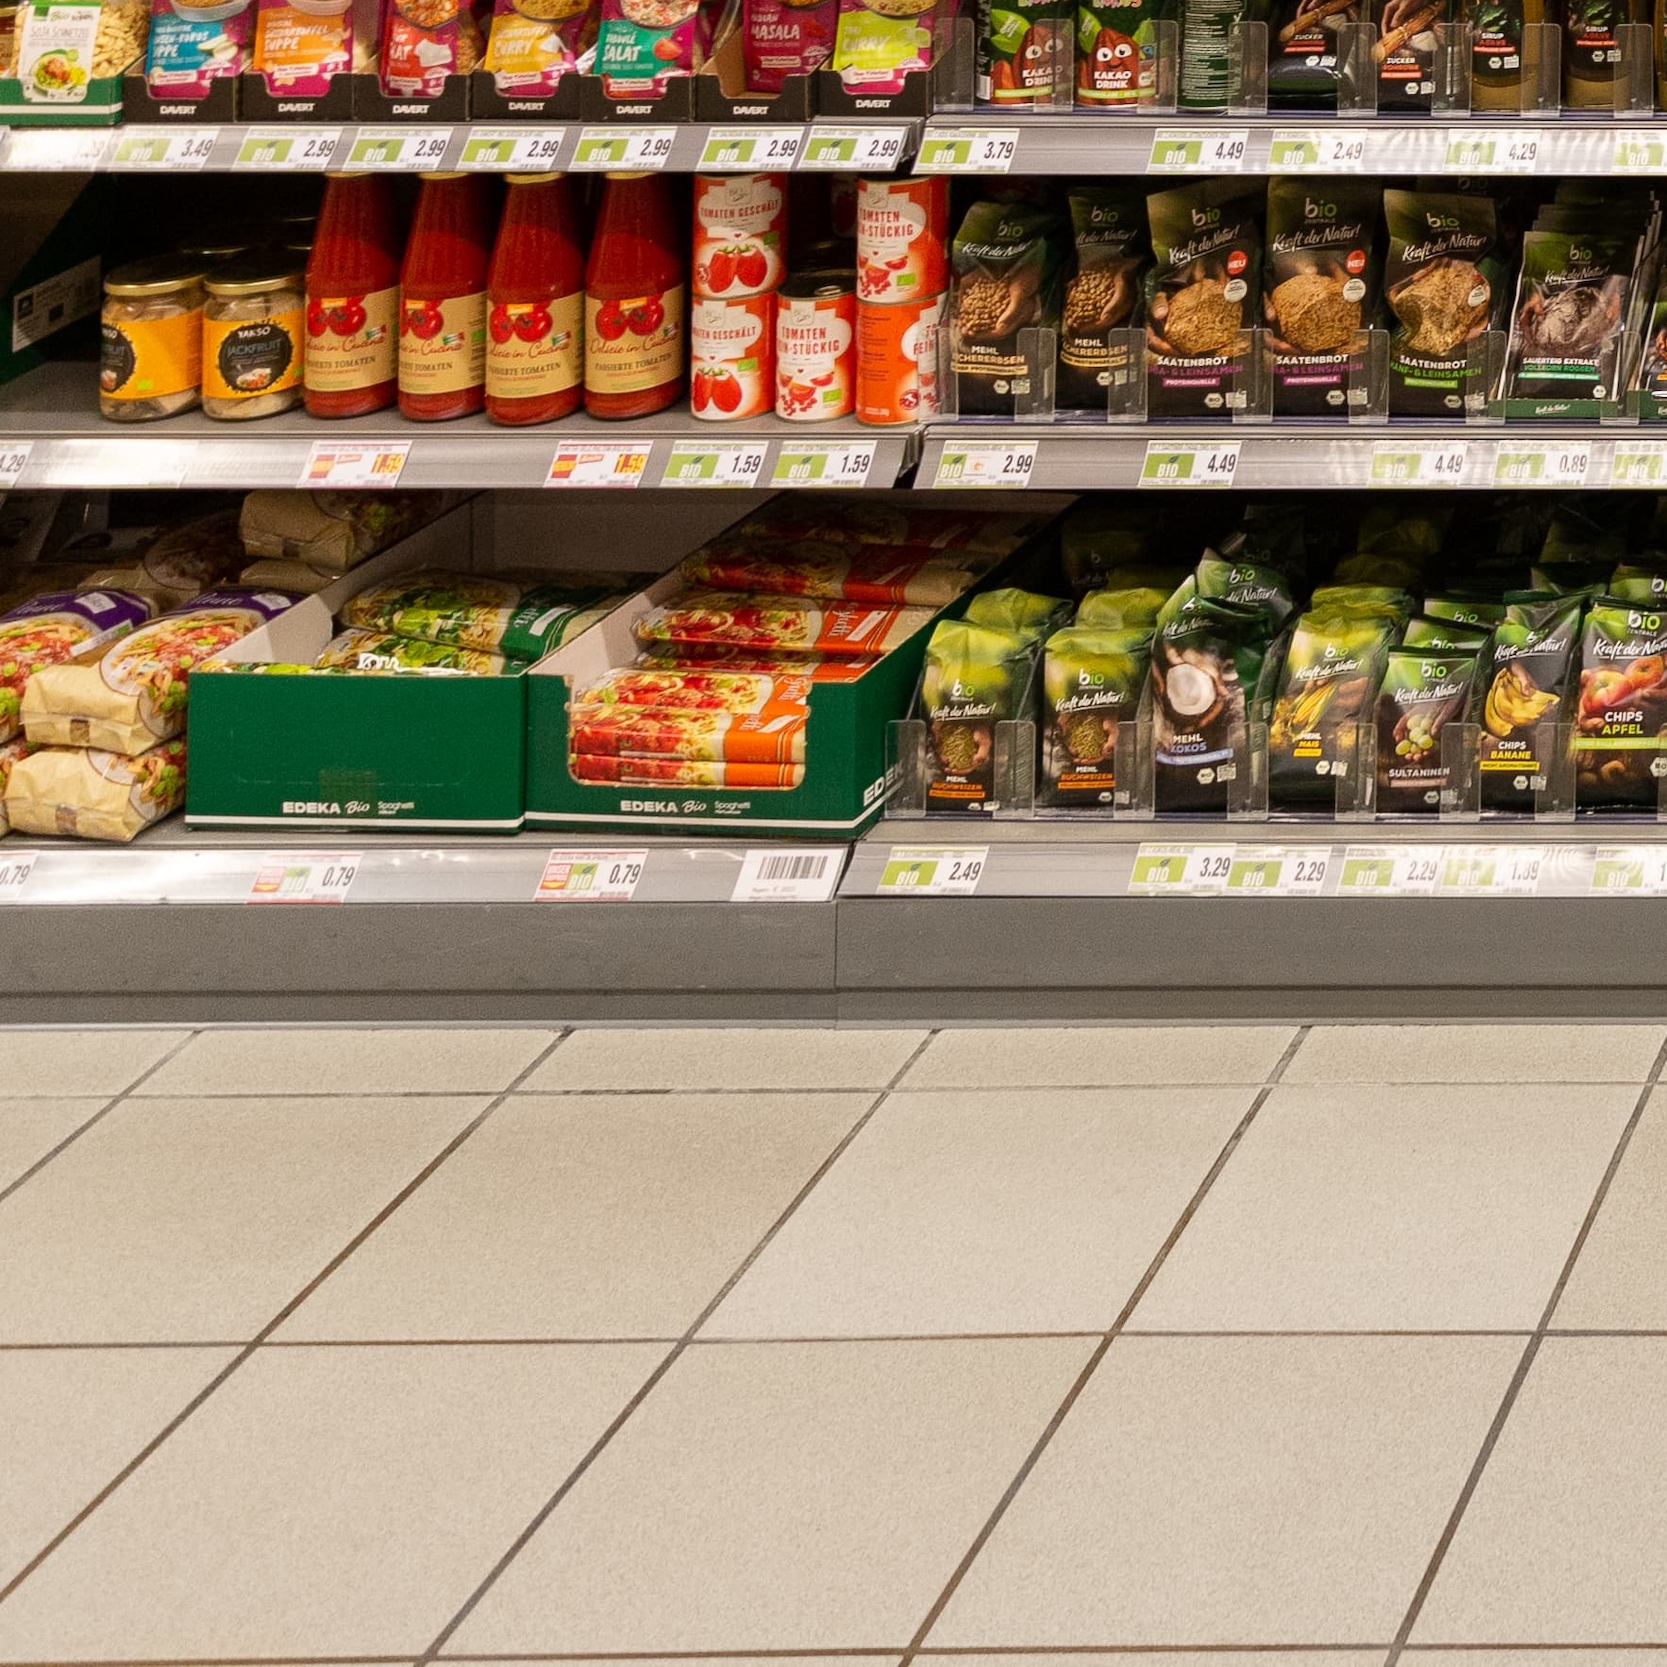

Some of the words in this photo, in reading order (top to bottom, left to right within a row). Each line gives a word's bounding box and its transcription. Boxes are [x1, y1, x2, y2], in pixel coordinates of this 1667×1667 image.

[603, 46, 641, 60] SALAT
[1094, 70, 1131, 80] KAKAO
[1096, 79, 1128, 88] DRINK
[818, 147, 840, 160] BIO
[868, 139, 898, 156] 2.99
[1214, 141, 1244, 159] 4.49
[701, 208, 736, 219] TOMATEN
[738, 198, 781, 217] GESCHÄLT
[1346, 259, 1365, 268] NEU
[227, 339, 281, 357] JACKFRUIT
[1276, 355, 1348, 367] SAATENBROT
[372, 455, 402, 473] 1.59
[680, 463, 700, 477] BIO
[733, 456, 761, 473] 1.59
[1156, 464, 1178, 478] BIO
[1208, 454, 1236, 472] 4.49
[1604, 712, 1643, 723] CHIPS
[1603, 724, 1643, 734] APFEL
[1389, 768, 1450, 778] SULTANINEN
[282, 802, 341, 815] EDEKA
[345, 800, 370, 815] Bio
[621, 801, 678, 813] EDEKA
[682, 800, 707, 813] Bio
[569, 874, 592, 888] BIO
[608, 865, 640, 884] 0.79
